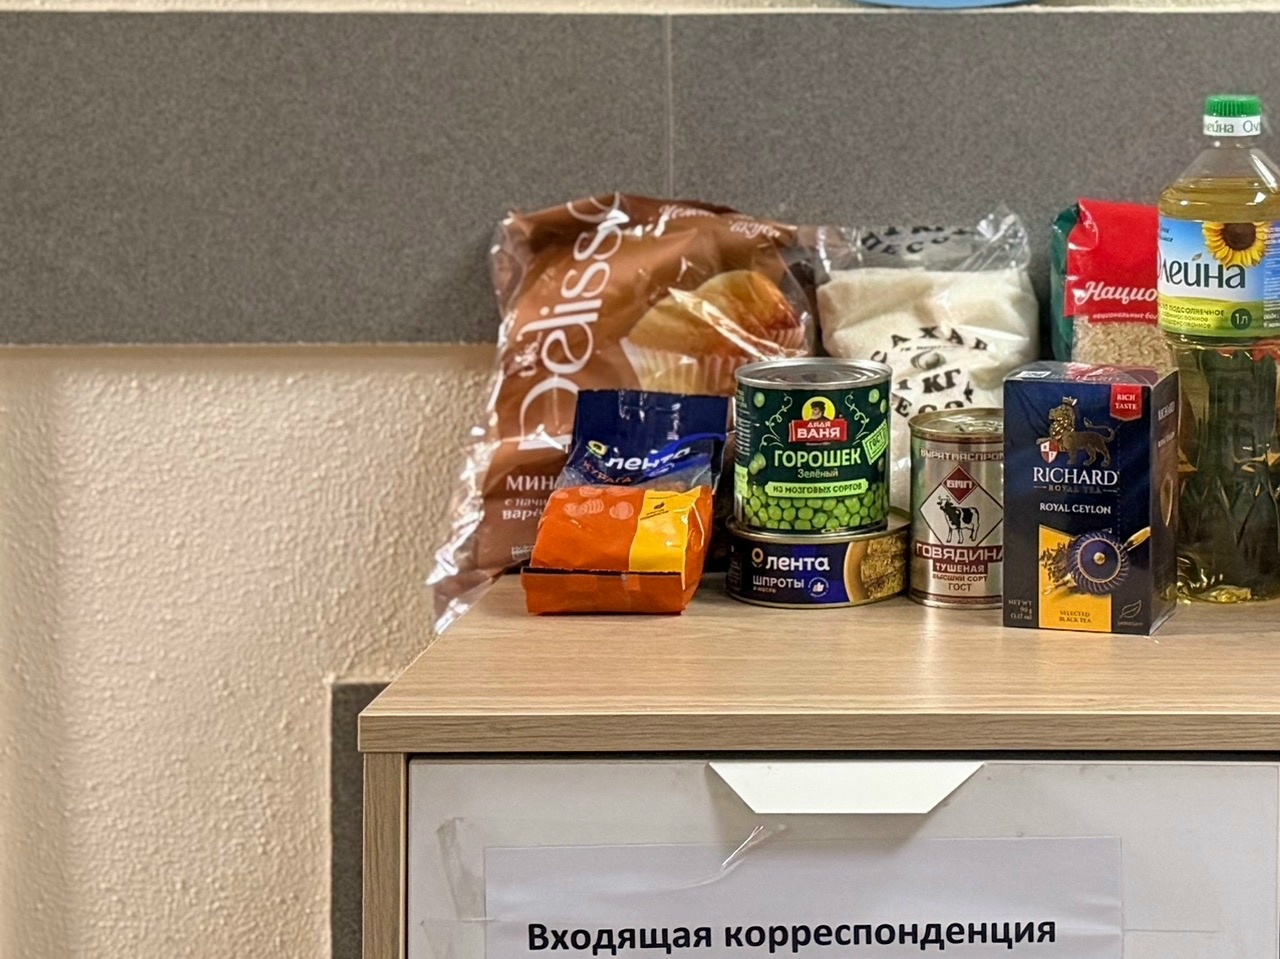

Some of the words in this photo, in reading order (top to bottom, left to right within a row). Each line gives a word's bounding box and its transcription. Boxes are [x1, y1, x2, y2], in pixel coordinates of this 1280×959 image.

[1116, 393, 1136, 401] RICH
[797, 427, 841, 439] ВАНЯ
[774, 448, 861, 468] ГОРОШЕК
[1033, 466, 1119, 486] RICHARD
[785, 486, 831, 494] МОЗГОВЫХ
[832, 483, 862, 493] СОРТОВ
[1040, 502, 1070, 513] ROYAL
[1072, 504, 1112, 515] CEYLON
[765, 556, 831, 571] лента
[935, 563, 985, 573] ТУШЕНАЯ
[753, 574, 805, 589] ШПРОТЫ
[948, 583, 972, 591] ГОСТ
[527, 920, 713, 957] Входящая
[724, 916, 1056, 955] корреспонденция
